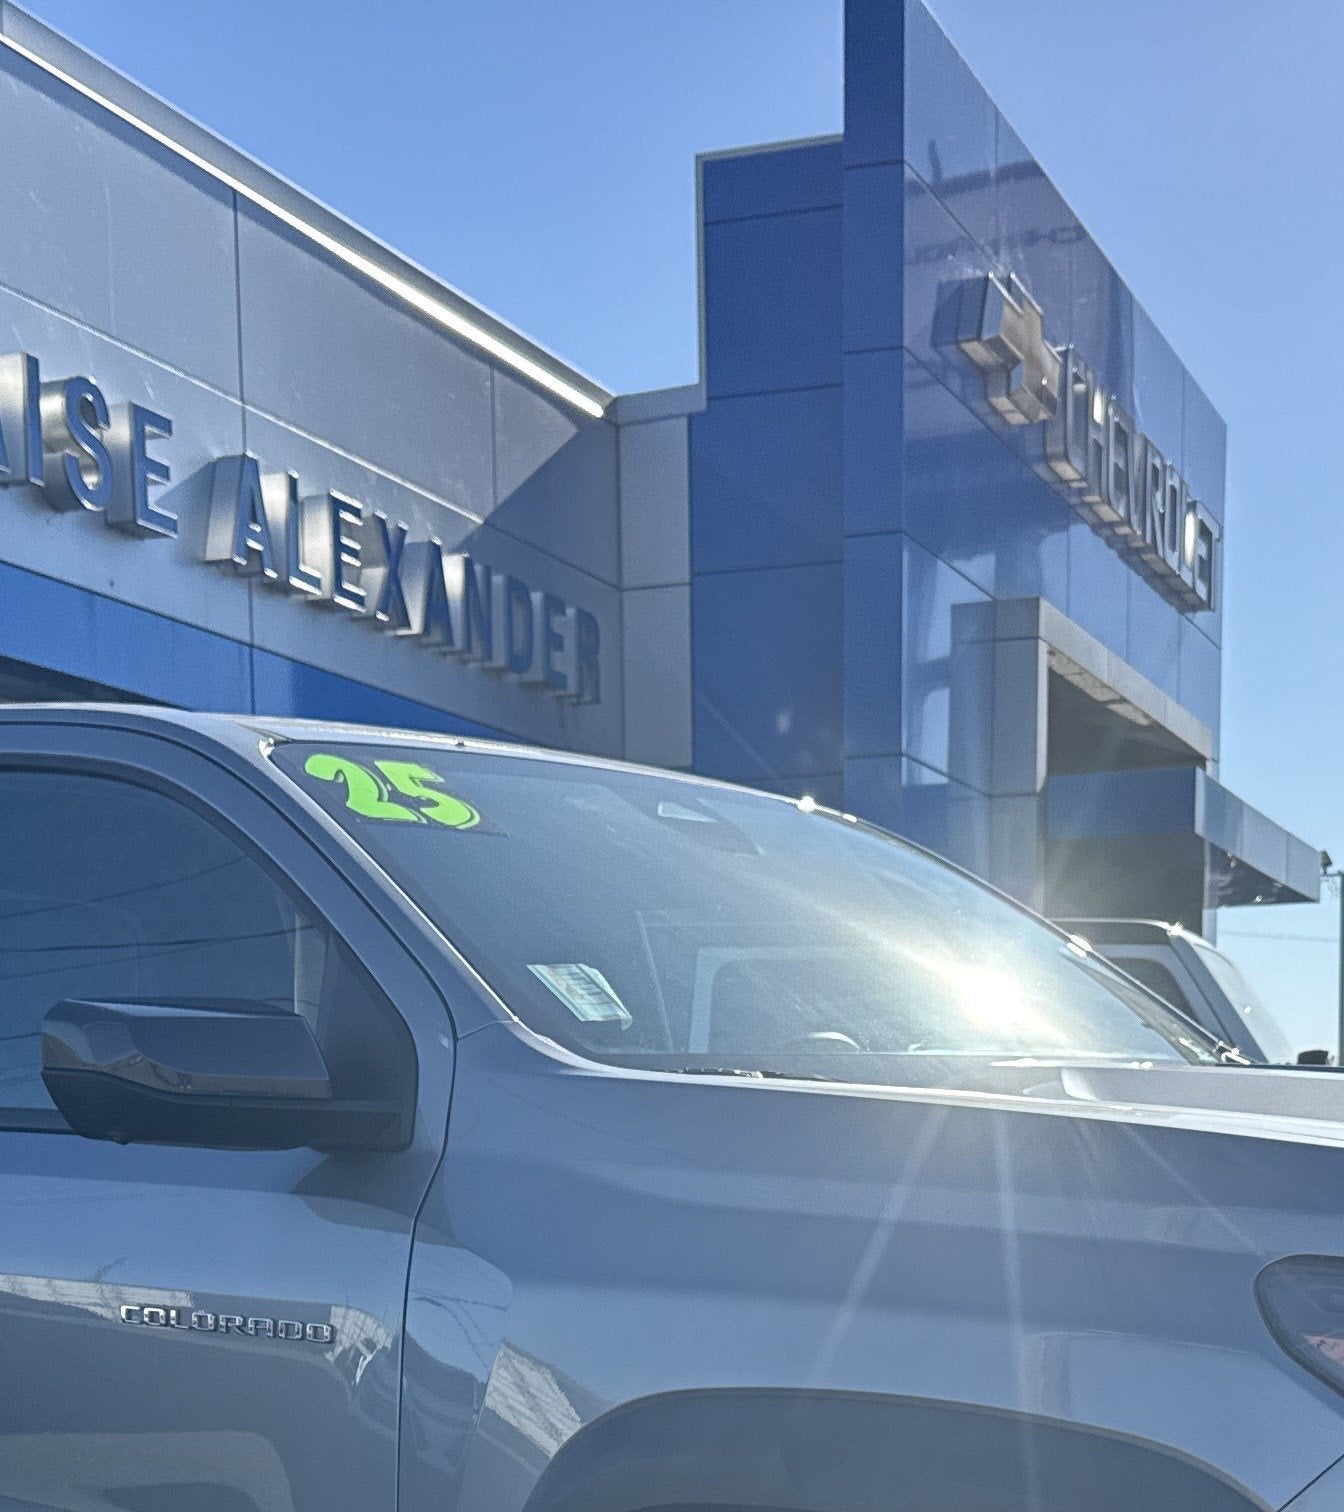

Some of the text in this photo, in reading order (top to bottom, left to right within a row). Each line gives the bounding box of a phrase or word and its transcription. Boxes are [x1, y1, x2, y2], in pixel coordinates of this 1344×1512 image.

[209, 452, 601, 703] ALEXANDER
[304, 753, 483, 829] 25
[120, 1304, 334, 1343] COLORADO
